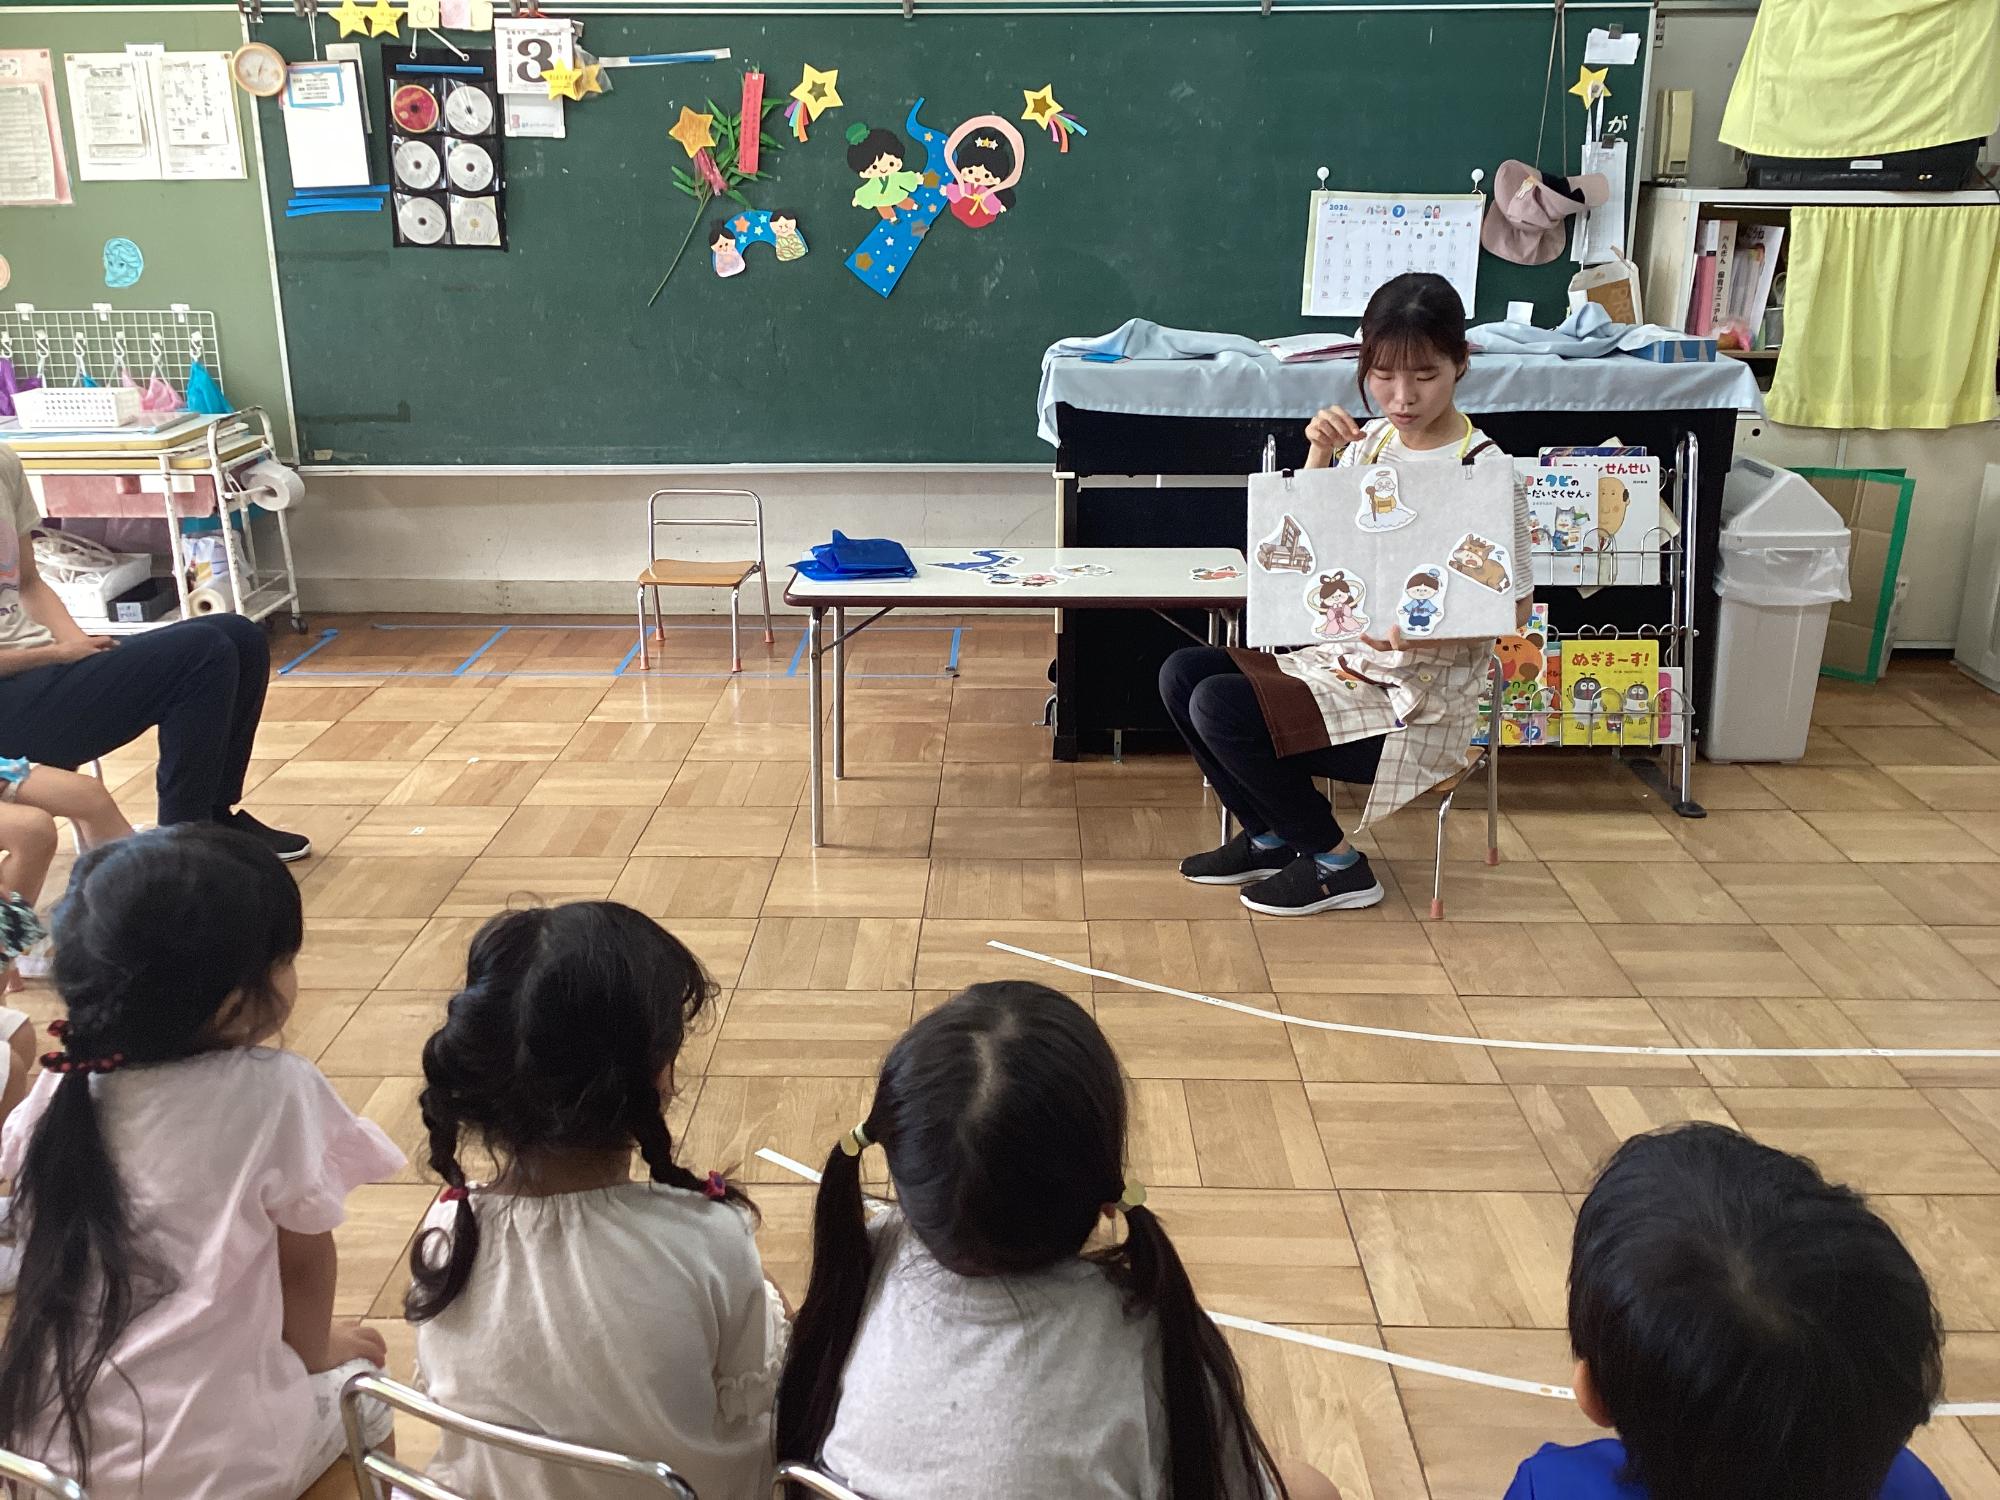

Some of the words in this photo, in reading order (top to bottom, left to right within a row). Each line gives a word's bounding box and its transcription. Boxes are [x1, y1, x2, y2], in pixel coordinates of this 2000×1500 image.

[517, 38, 554, 83] 3
[1608, 115, 1628, 133] が
[1572, 651, 1650, 667] ぬぎまーす!
